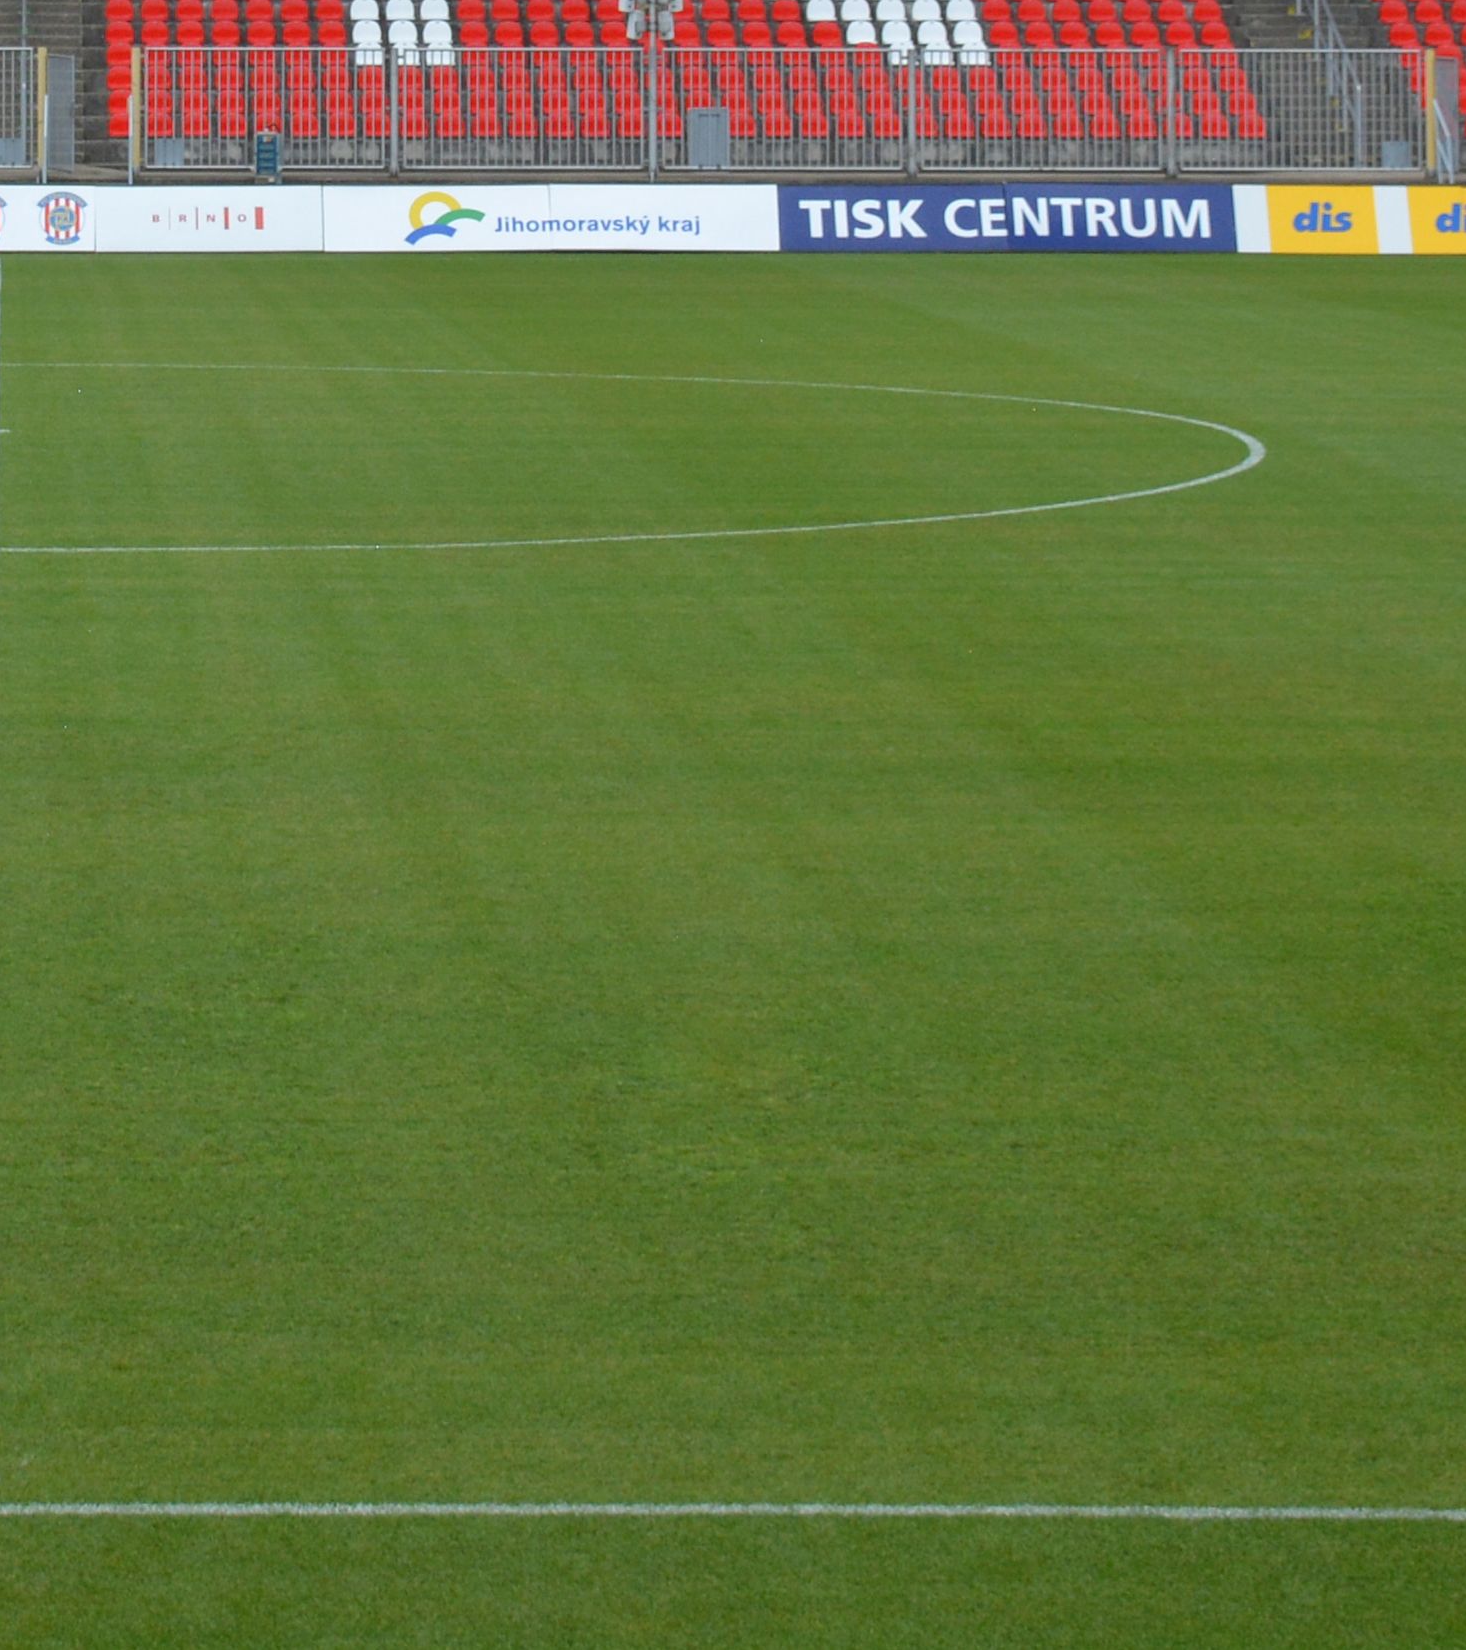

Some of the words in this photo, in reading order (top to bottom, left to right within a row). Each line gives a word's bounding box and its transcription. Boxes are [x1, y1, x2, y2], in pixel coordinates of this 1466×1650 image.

[494, 215, 650, 236] Jihomoravský
[657, 215, 701, 236] kraj
[798, 199, 928, 239] TISK
[943, 197, 1212, 239] CENTRUM
[1293, 202, 1353, 233] dis
